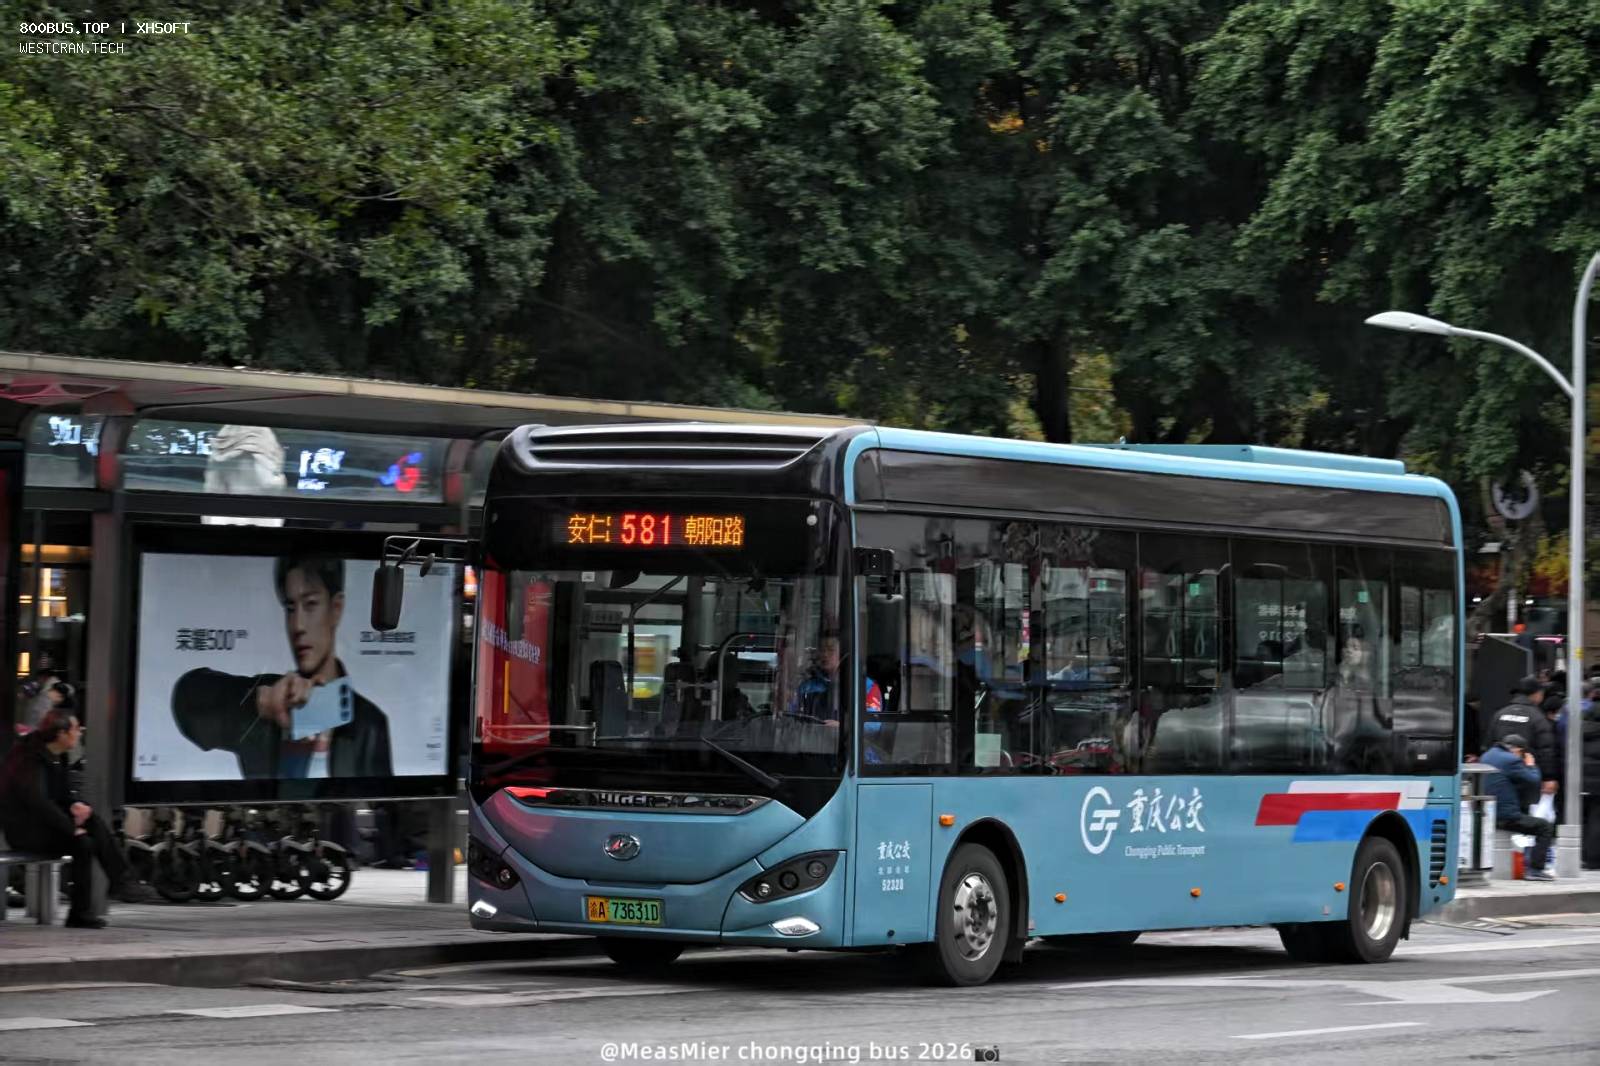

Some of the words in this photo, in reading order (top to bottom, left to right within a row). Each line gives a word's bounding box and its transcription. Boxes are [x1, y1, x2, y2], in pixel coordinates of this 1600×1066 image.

[567, 514, 611, 543] 安仁
[621, 514, 671, 545] 581
[684, 515, 744, 545] 朝阳路
[1126, 787, 1205, 833] 重庆公交
[877, 840, 911, 860] 重庆公交
